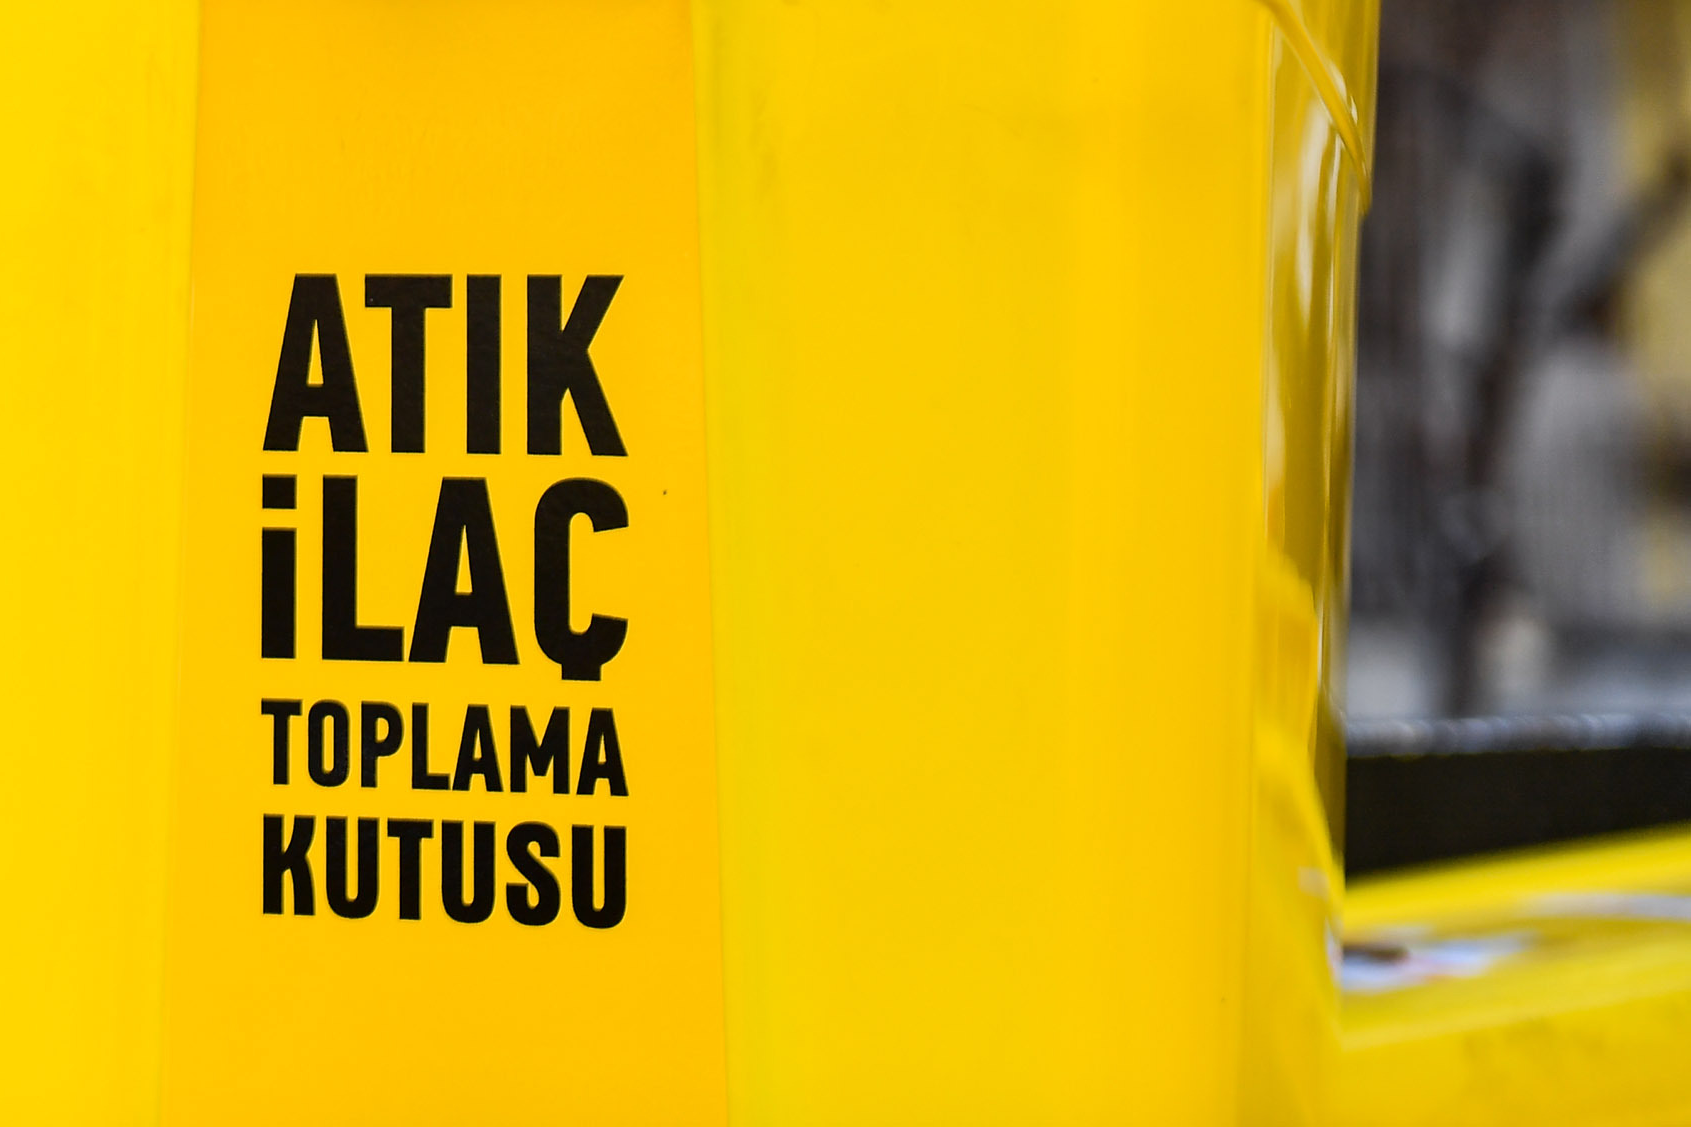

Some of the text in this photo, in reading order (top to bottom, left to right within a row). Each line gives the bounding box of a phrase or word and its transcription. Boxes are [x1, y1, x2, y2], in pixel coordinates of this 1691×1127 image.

[262, 273, 629, 457] ATIK
[261, 698, 629, 796] TOPLAMA
[262, 814, 627, 929] KUTUSU
